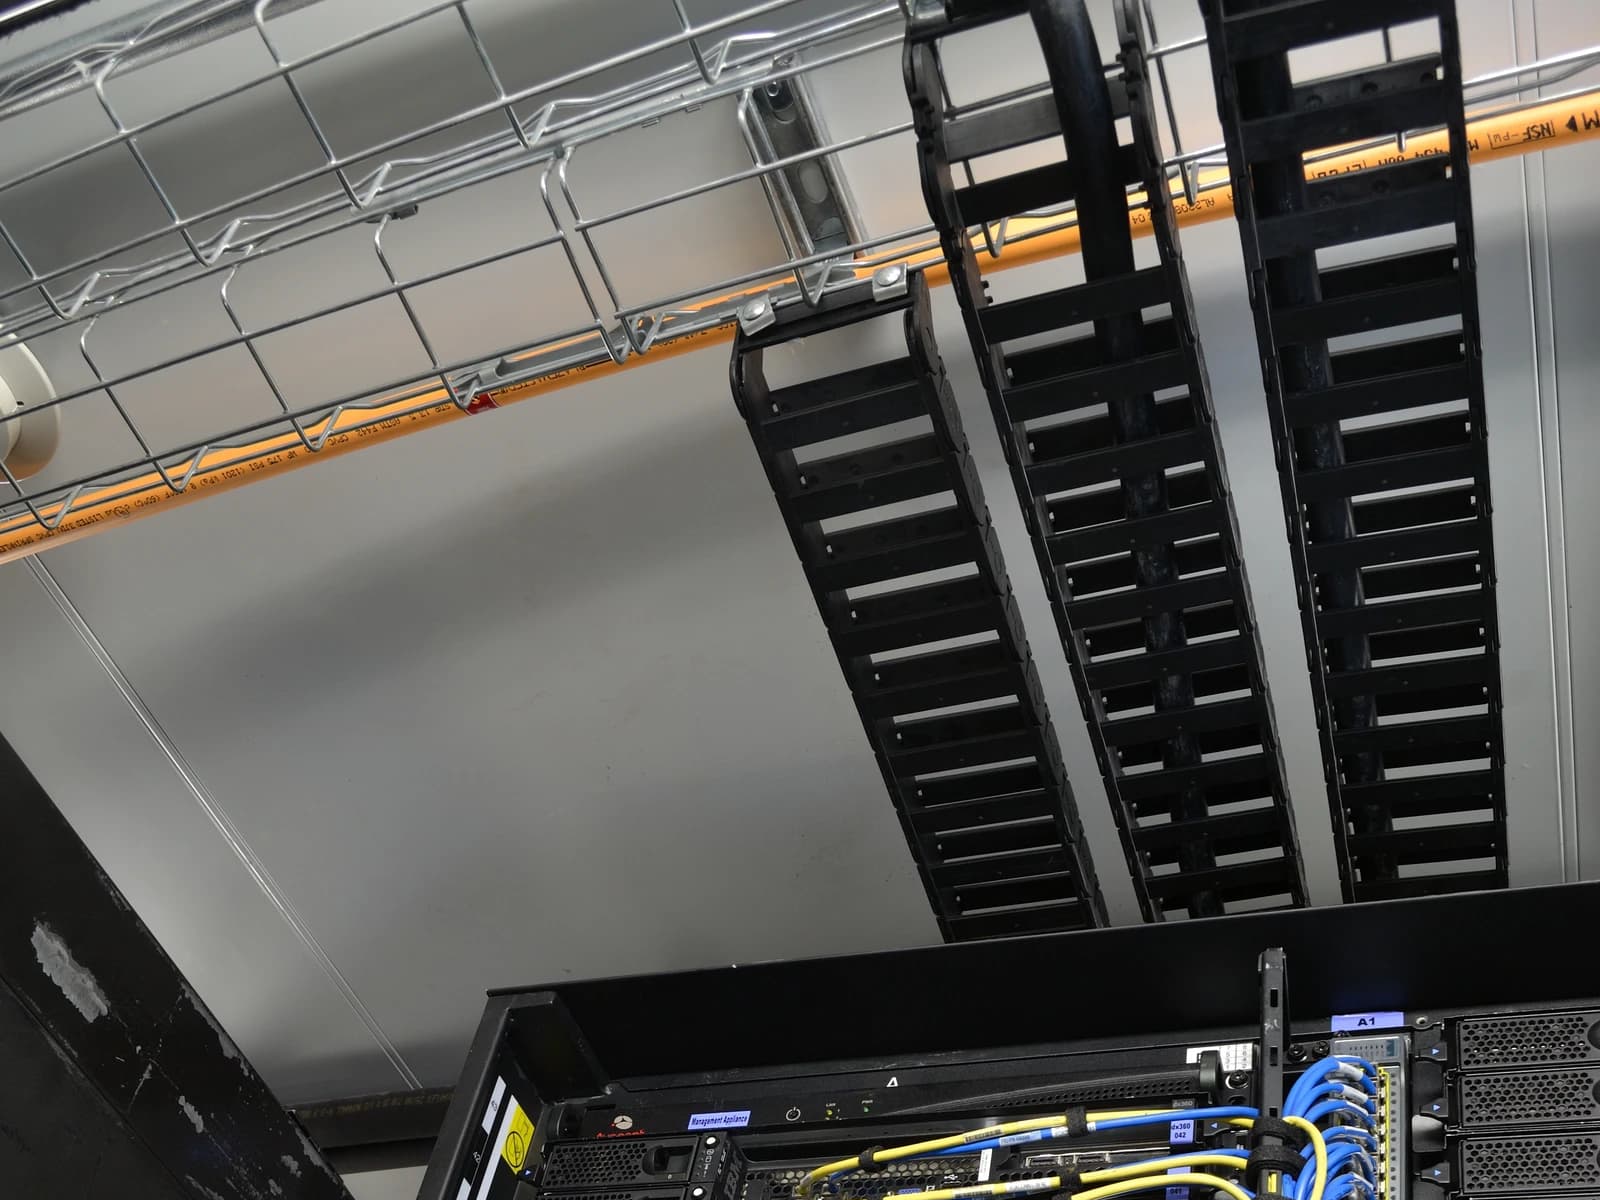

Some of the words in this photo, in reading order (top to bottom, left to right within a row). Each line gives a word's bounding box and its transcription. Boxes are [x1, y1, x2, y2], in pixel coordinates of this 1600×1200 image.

[1357, 1017, 1375, 1027] A1
[691, 1116, 722, 1126] Management
[723, 1114, 748, 1125] Appliance
[1171, 1122, 1191, 1130] dx360
[1174, 1131, 1187, 1139] 042
